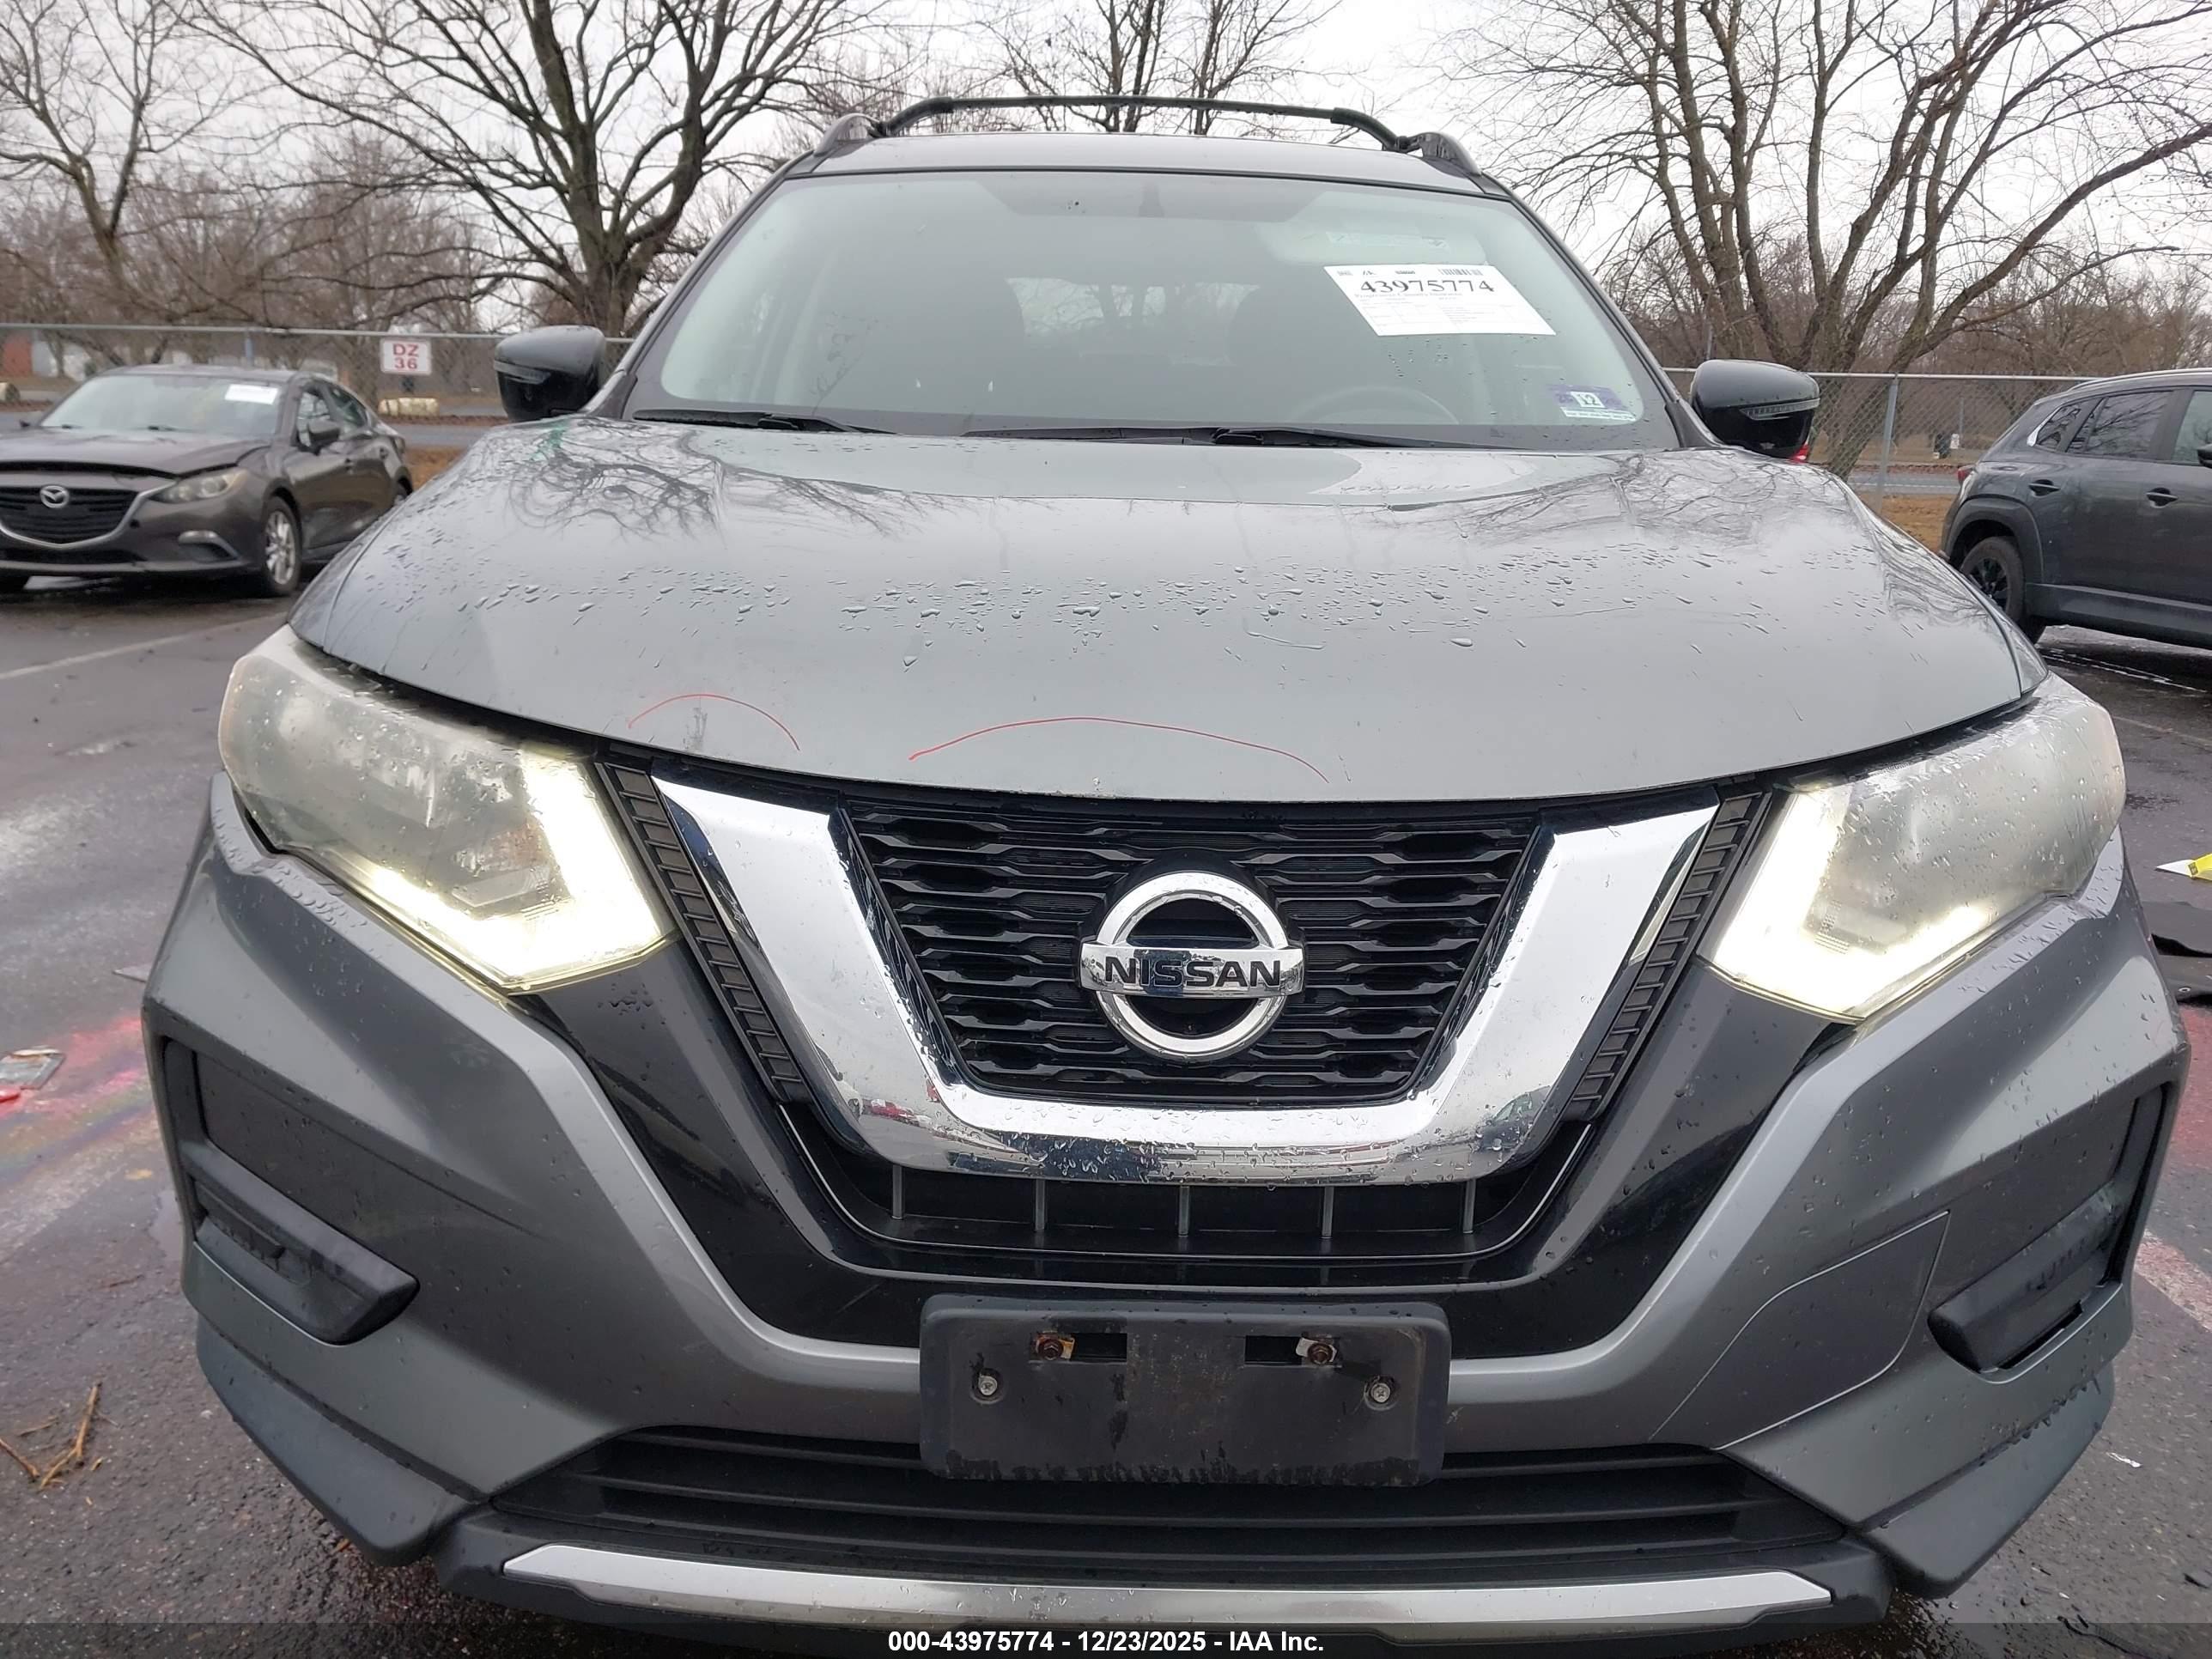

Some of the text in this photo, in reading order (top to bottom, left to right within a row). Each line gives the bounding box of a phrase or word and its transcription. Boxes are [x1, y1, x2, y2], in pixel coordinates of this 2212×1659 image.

[1360, 279, 1495, 293] 43975774
[392, 343, 420, 357] DZ
[394, 357, 418, 370] 36
[1577, 392, 1601, 406] 12
[1104, 956, 1281, 988] NISSAN
